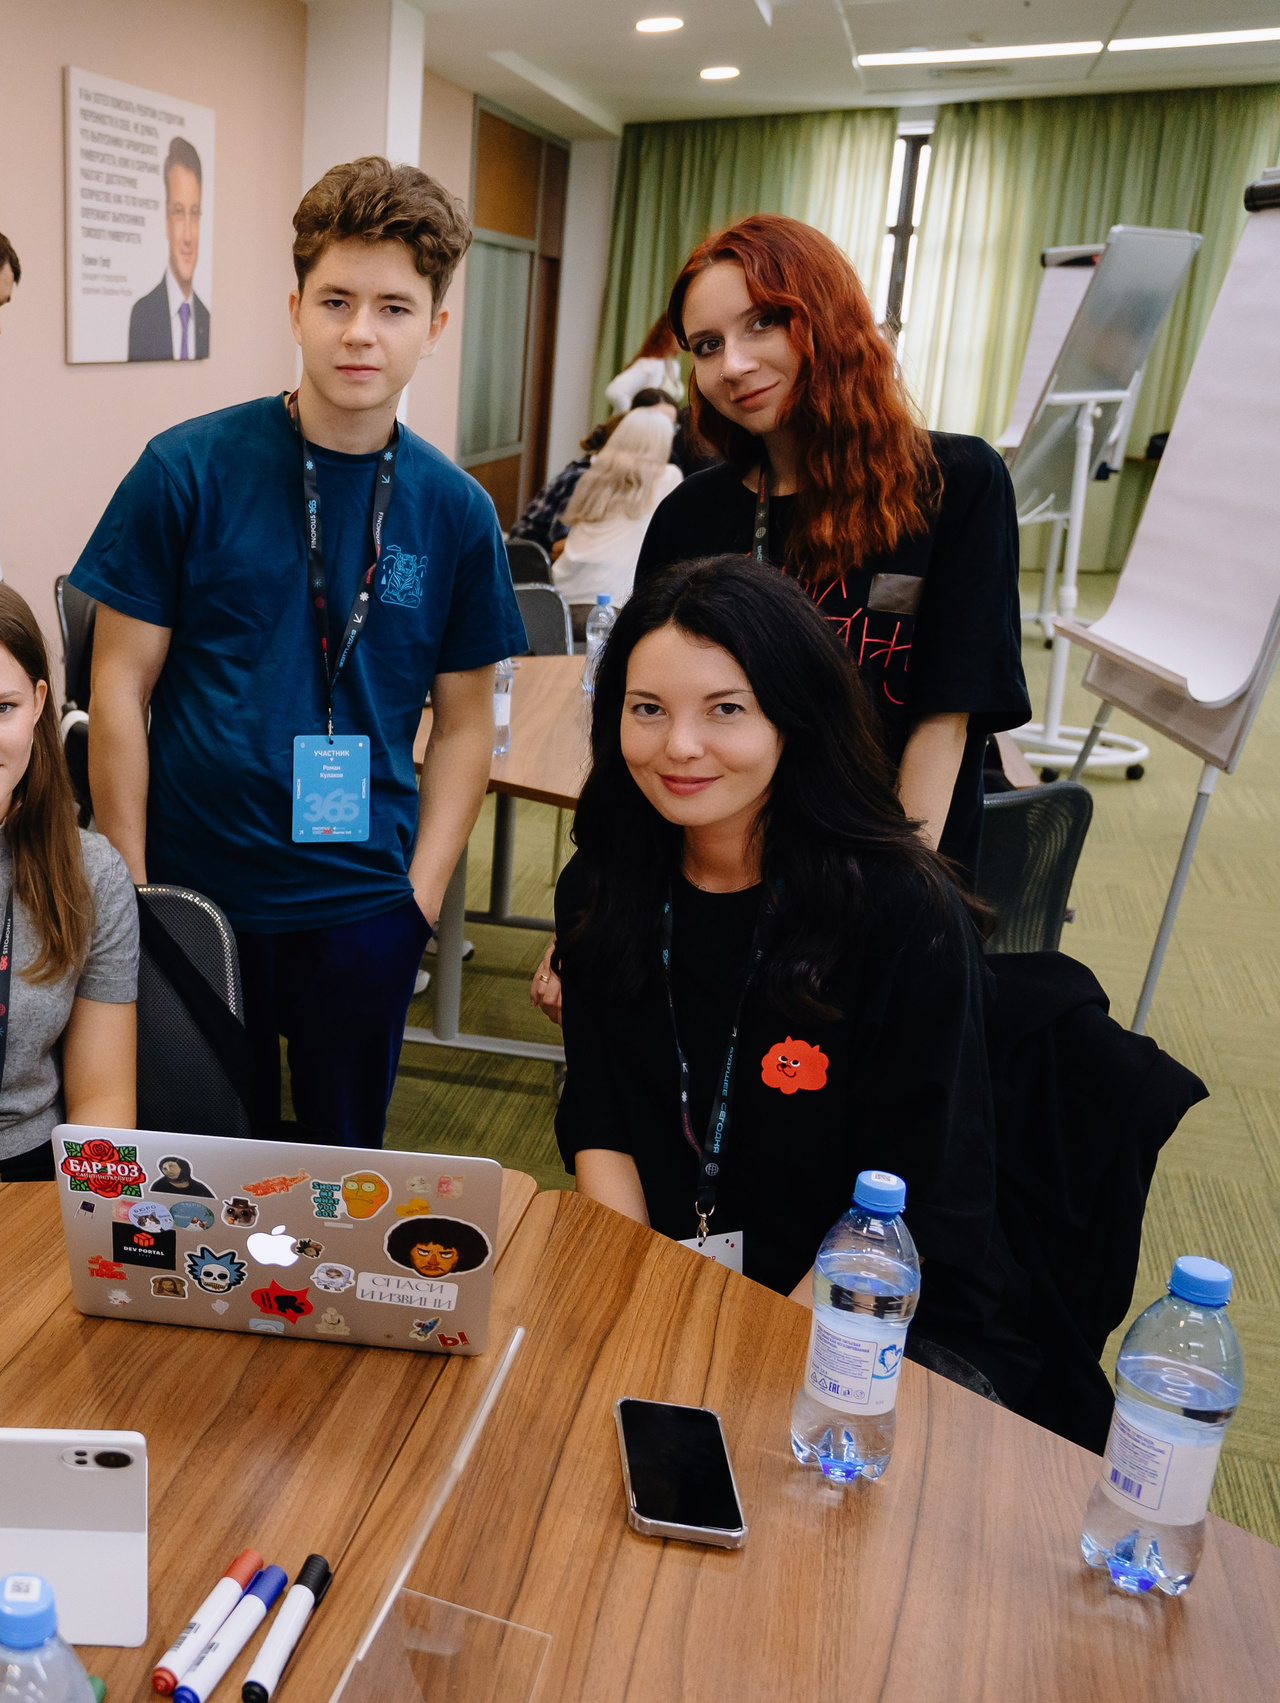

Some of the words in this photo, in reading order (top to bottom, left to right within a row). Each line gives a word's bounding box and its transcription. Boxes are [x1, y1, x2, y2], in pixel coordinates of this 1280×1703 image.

[308, 499, 317, 514] 365
[303, 788, 360, 822] 365
[3, 918, 11, 955] FINOPOLIS
[722, 1046, 734, 1096] БУДУЩЕЕ
[713, 1102, 727, 1153] СЕГОДНЯ
[69, 1159, 102, 1174] БАР
[107, 1162, 139, 1177] РОЗ
[312, 1181, 341, 1191] SHOW
[133, 1205, 157, 1213] БЮРО
[313, 1196, 340, 1205] WHAT
[317, 1203, 336, 1211] YOU
[139, 1248, 165, 1256] PORTAL
[372, 1276, 444, 1294] СПАСИ
[361, 1289, 374, 1300] И
[379, 1291, 451, 1309] ИЗВИНИ
